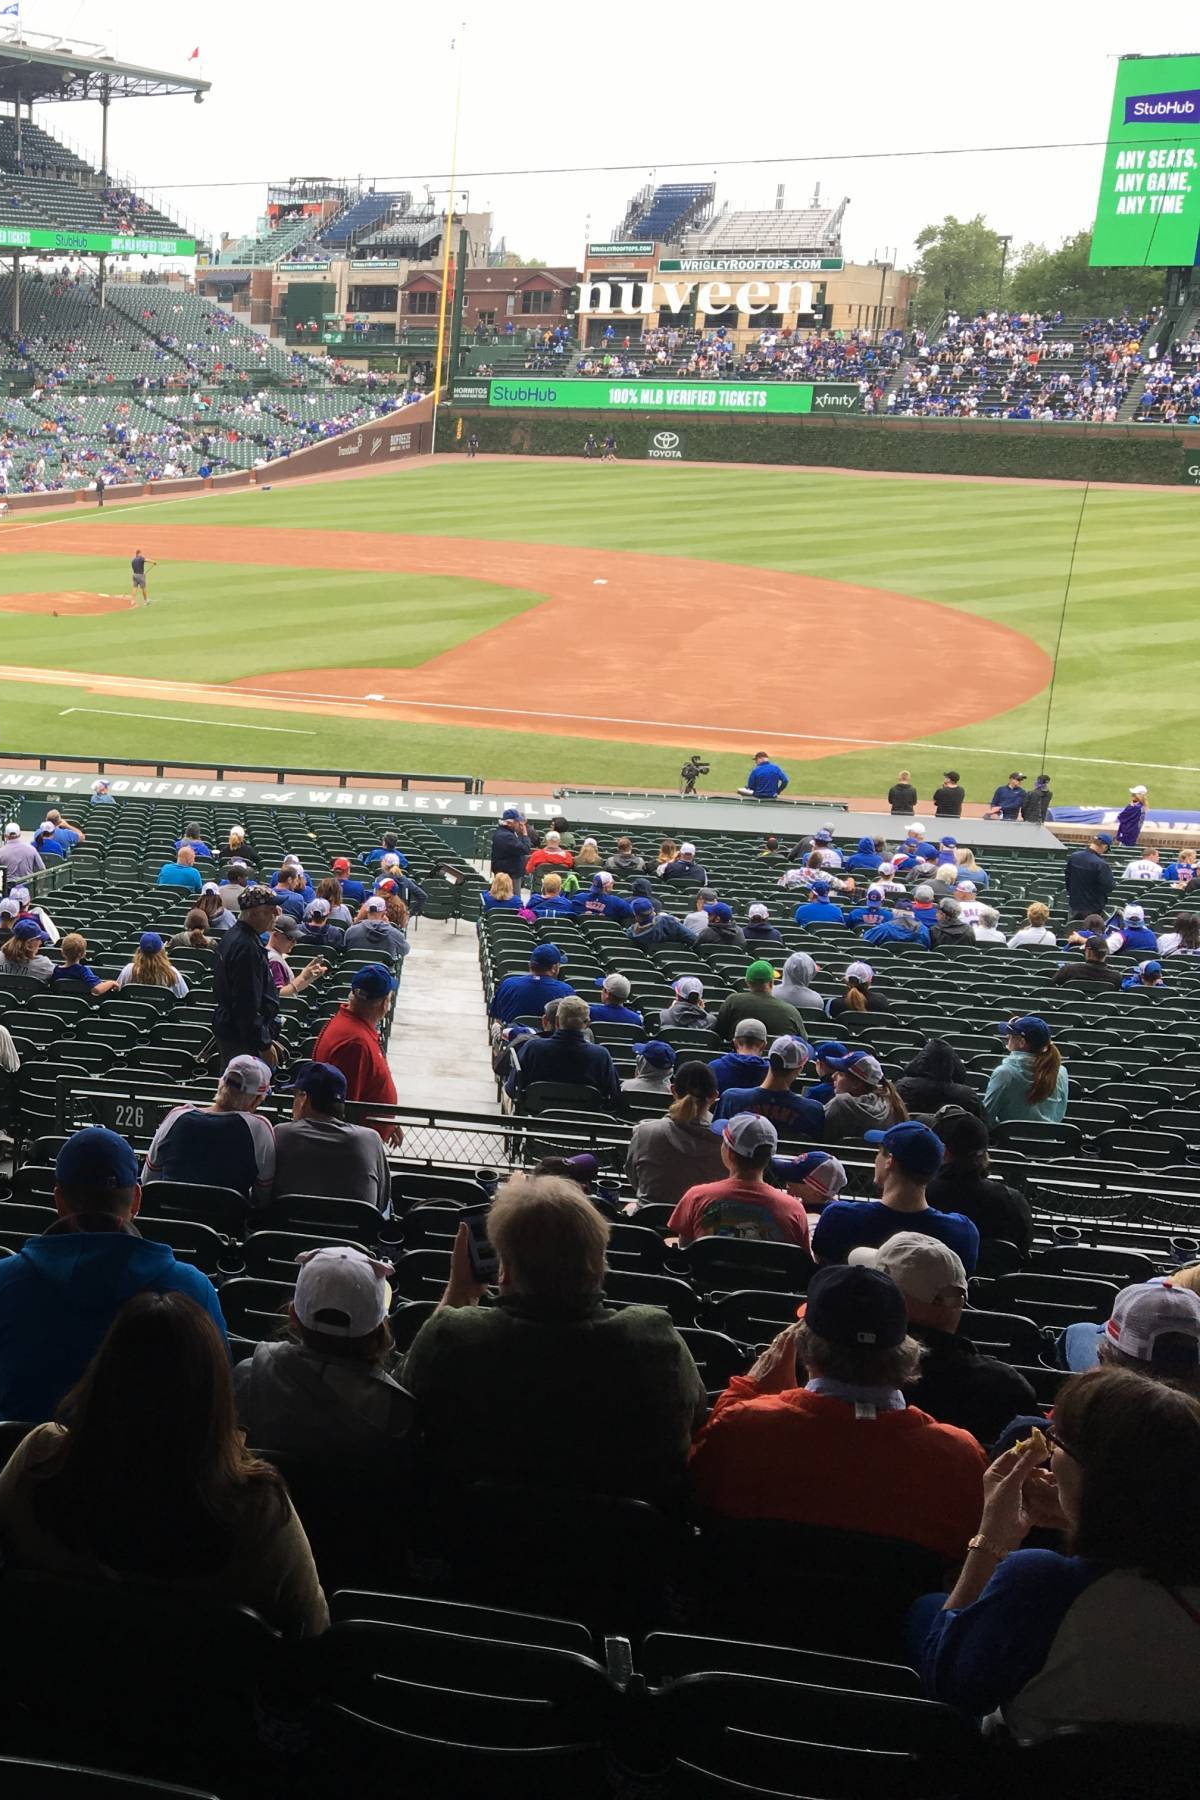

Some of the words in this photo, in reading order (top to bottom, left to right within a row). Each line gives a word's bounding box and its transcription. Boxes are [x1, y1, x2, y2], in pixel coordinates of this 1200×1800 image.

[1133, 101, 1195, 116] StubHub
[1115, 150, 1146, 170] ANY
[1147, 148, 1198, 170] SEATS,
[1115, 172, 1145, 192] ANY
[1146, 172, 1192, 192] GAME,
[1116, 195, 1146, 215] ANY
[1149, 194, 1185, 214] TIME
[55, 234, 87, 248] StubHub
[680, 259, 822, 271] WRIGLEYROOFTOPS.COM
[575, 280, 816, 315] nuveen
[493, 386, 557, 402] StubHub
[608, 388, 639, 404] 100%
[640, 388, 664, 405] MLB
[666, 389, 717, 406] VERIFIED
[719, 390, 768, 407] TICKETS
[815, 393, 857, 408] xfinity
[647, 449, 683, 458] TOYOTA
[308, 791, 453, 811] WRIGLEY
[468, 800, 563, 816] FIELD
[116, 1105, 144, 1128] 226
